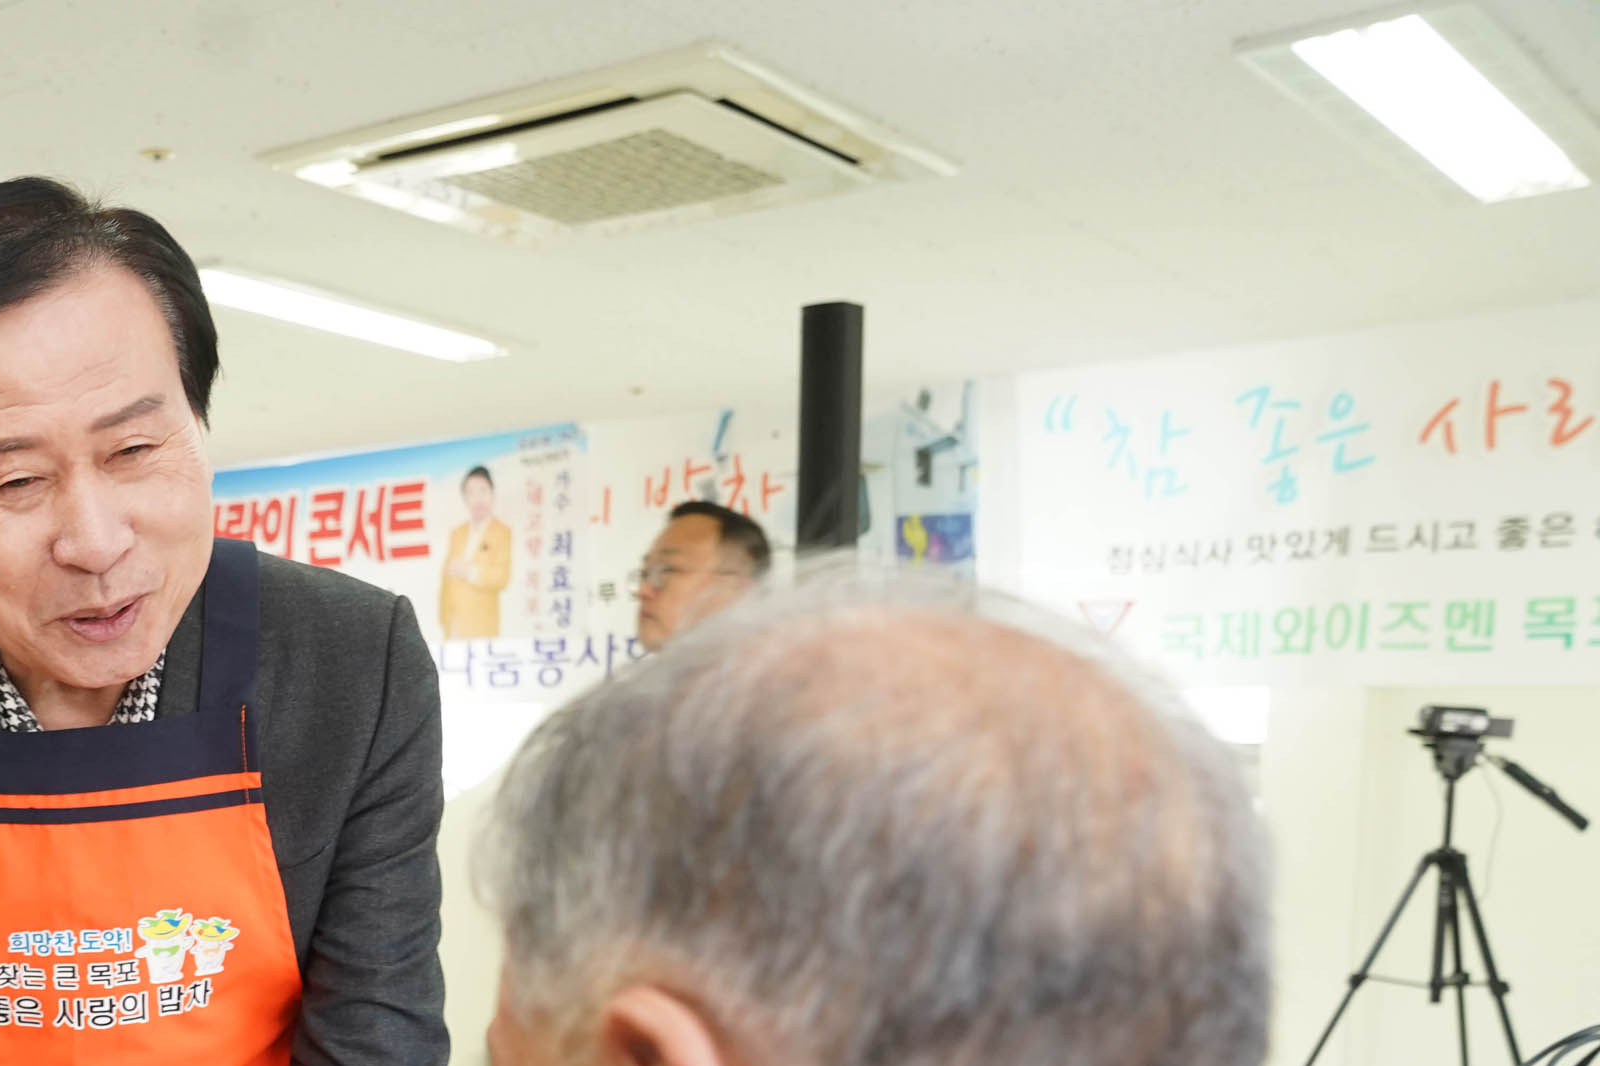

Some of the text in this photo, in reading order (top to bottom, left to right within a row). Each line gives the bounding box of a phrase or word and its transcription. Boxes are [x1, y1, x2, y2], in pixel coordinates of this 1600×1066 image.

[1236, 386, 1377, 506] 좋은
[308, 483, 431, 567] 콘서트
[1106, 536, 1234, 576] 점심식사
[1247, 524, 1352, 567] 맛있게
[1365, 518, 1478, 554] 드시고
[1496, 511, 1577, 551] 좋은
[1161, 597, 1496, 659] 국제와이즈멘
[11, 929, 131, 954] 희망찬 도약!
[55, 965, 78, 988] 큰
[90, 961, 138, 986] 목포
[56, 993, 146, 1027] 사랑의
[159, 980, 211, 1014] 밥차
